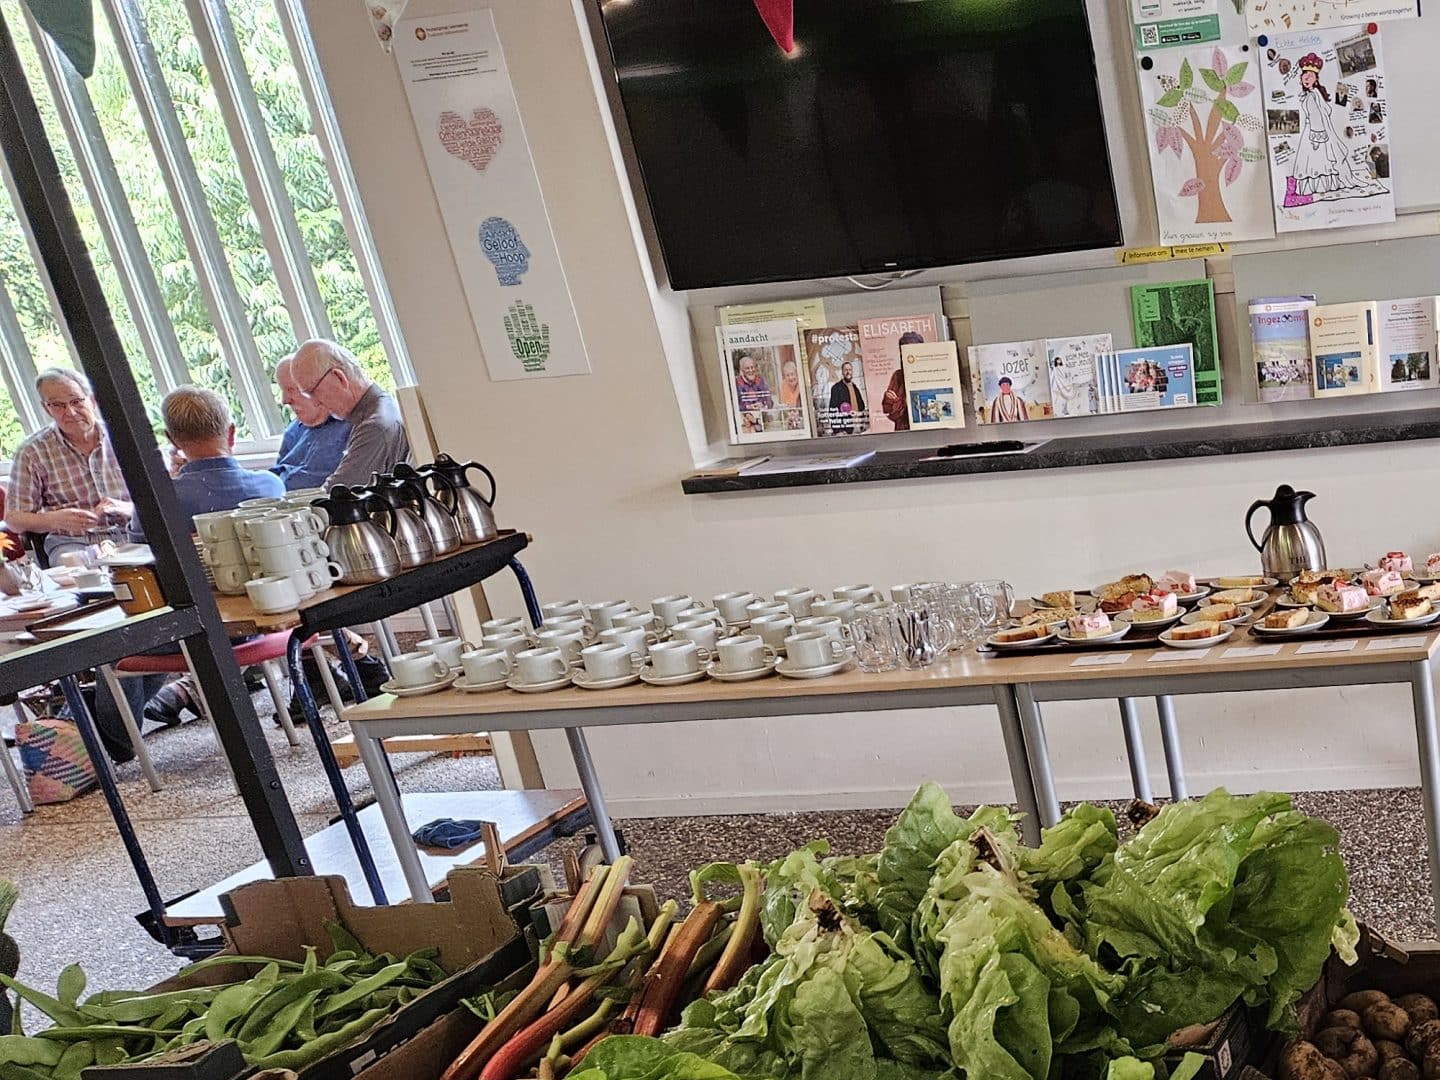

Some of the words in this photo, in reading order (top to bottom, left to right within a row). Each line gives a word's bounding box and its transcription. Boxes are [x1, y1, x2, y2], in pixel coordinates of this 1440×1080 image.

[484, 236, 518, 250] Geloof
[499, 252, 526, 264] Hoop
[863, 319, 932, 338] ELISABETH
[729, 334, 769, 344] aandacht
[515, 337, 542, 357] Open
